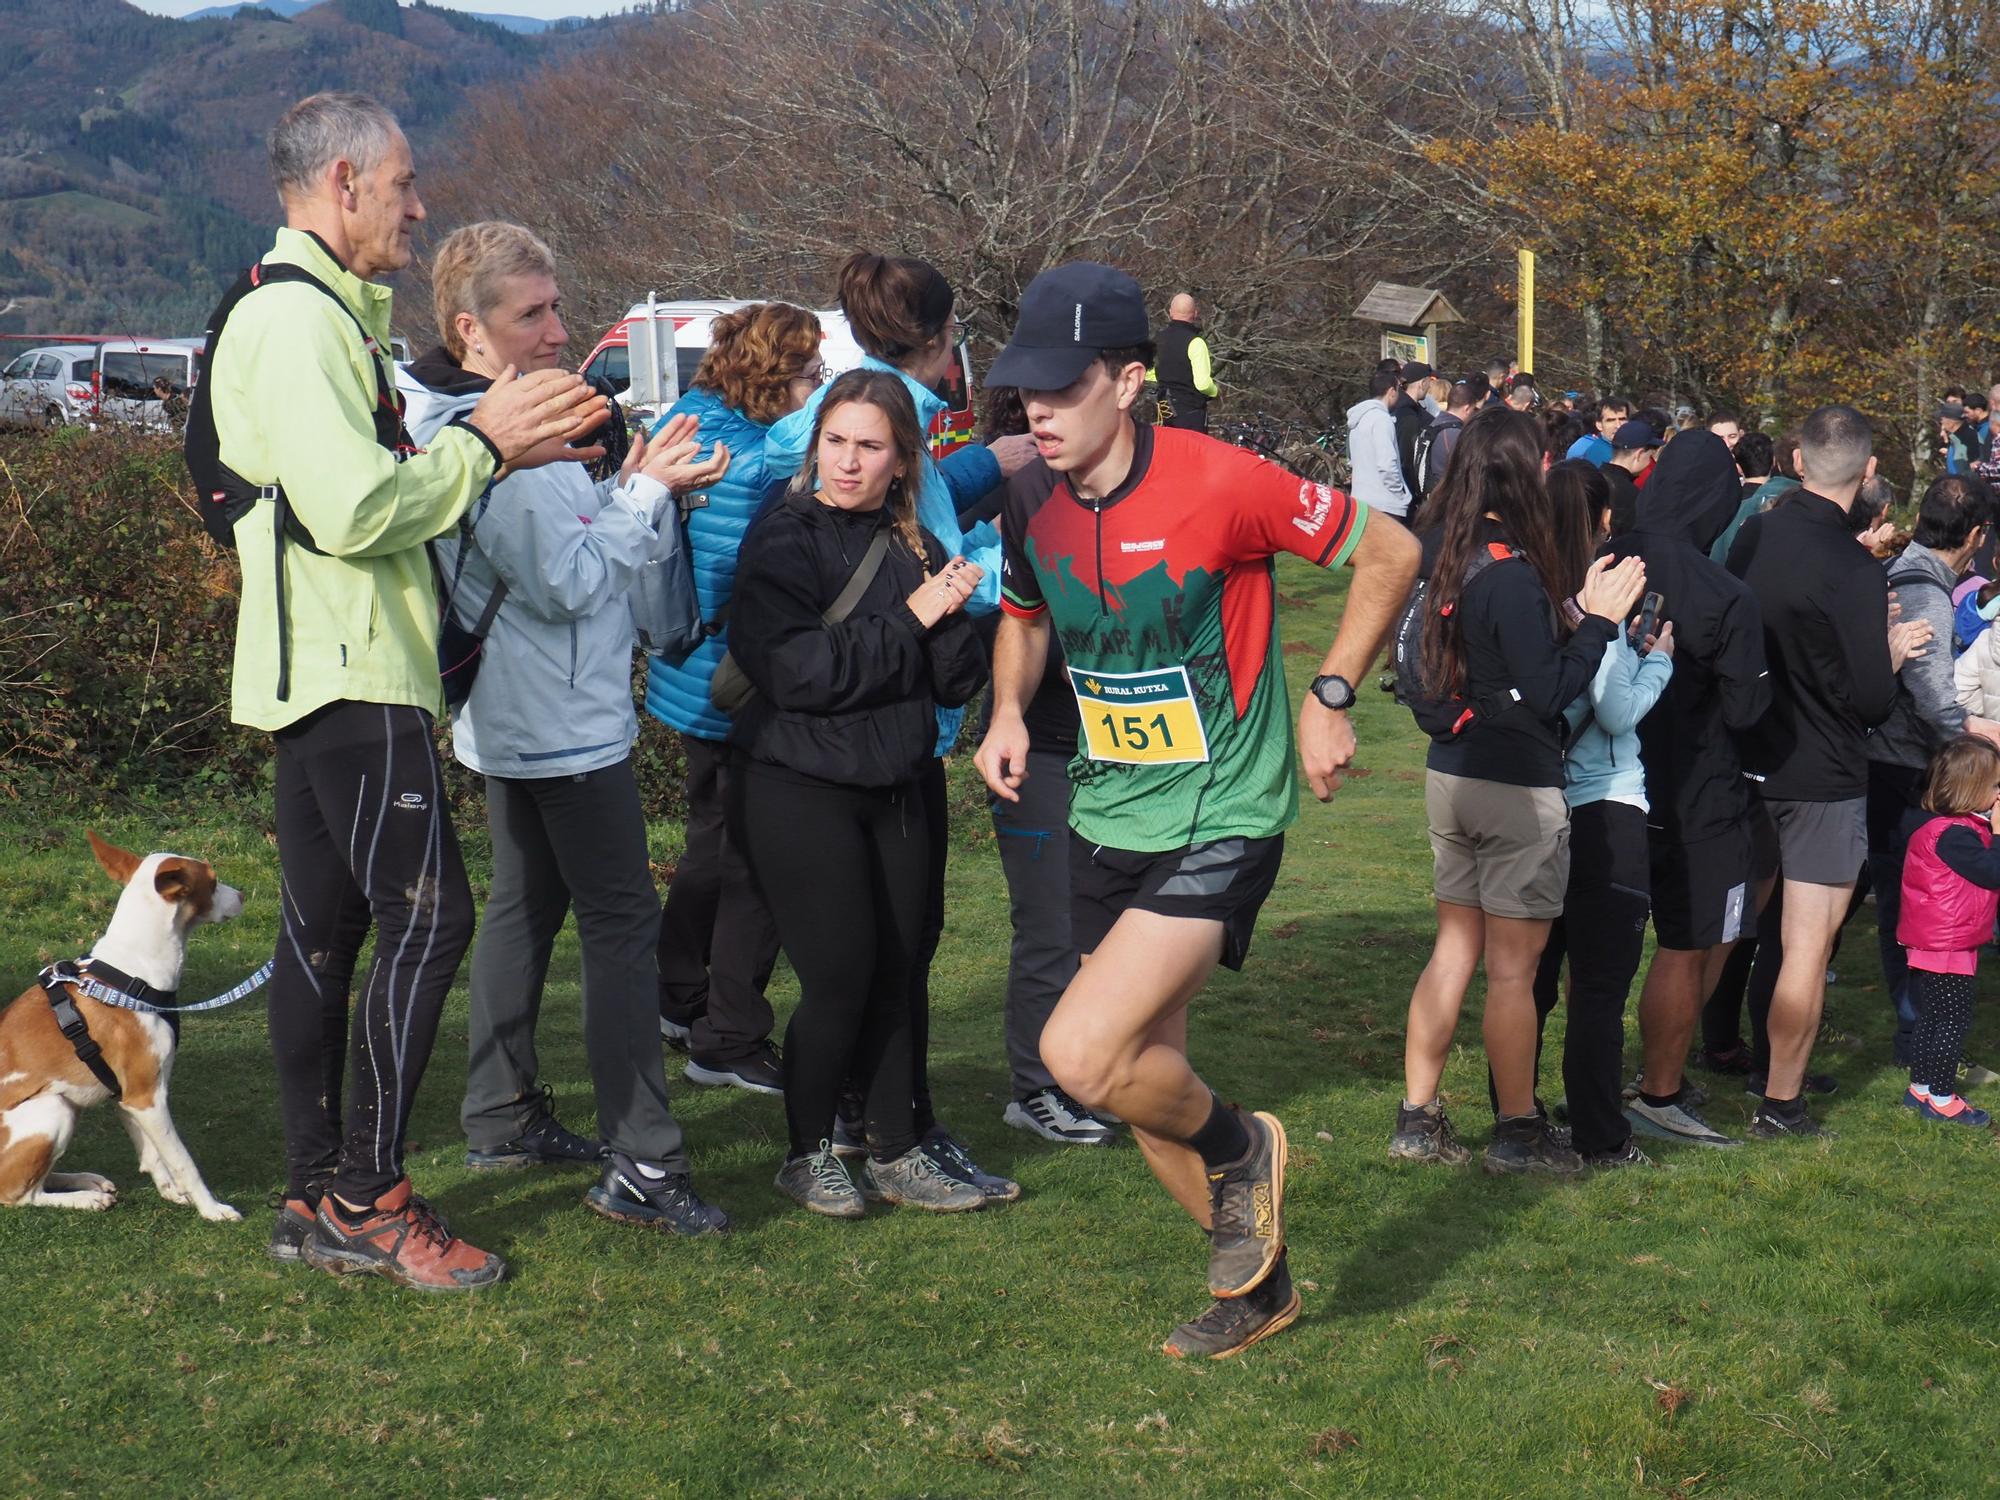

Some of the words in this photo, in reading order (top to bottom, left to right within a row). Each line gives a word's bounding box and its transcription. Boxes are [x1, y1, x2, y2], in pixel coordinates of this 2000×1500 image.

[1074, 303, 1082, 342] SALOMON
[1104, 686, 1133, 696] RURAL
[1133, 683, 1169, 695] KUTXA
[1101, 713, 1174, 750] 151
[617, 1175, 647, 1202] SALOMON
[320, 1211, 348, 1243] SALOMON
[1252, 1183, 1273, 1239] HOKA
